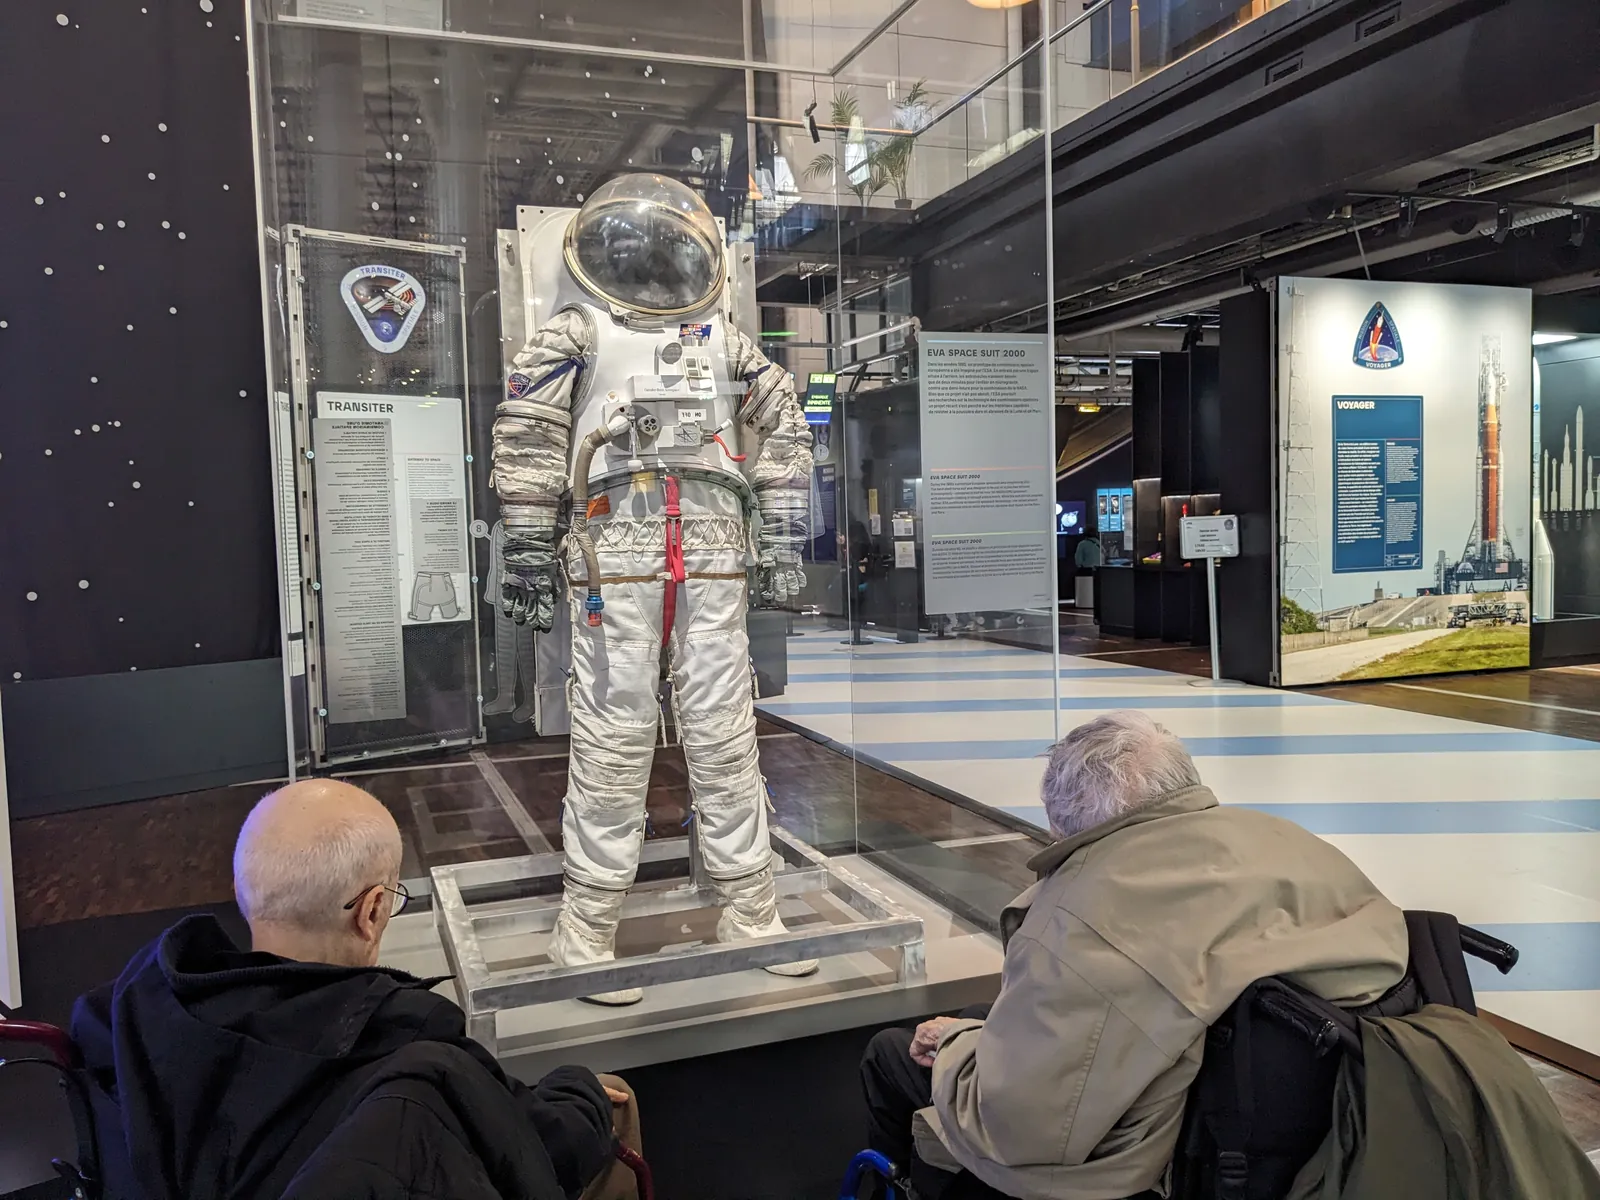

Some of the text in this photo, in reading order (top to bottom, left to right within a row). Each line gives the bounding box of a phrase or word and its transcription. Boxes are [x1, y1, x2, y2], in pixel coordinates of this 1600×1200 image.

[360, 266, 406, 280] TRANSITER
[928, 348, 1026, 357] EVA SPACE SUIT 2000
[327, 401, 394, 414] TRANSITER
[1337, 401, 1375, 410] VOYAGER
[476, 524, 482, 532] 8
